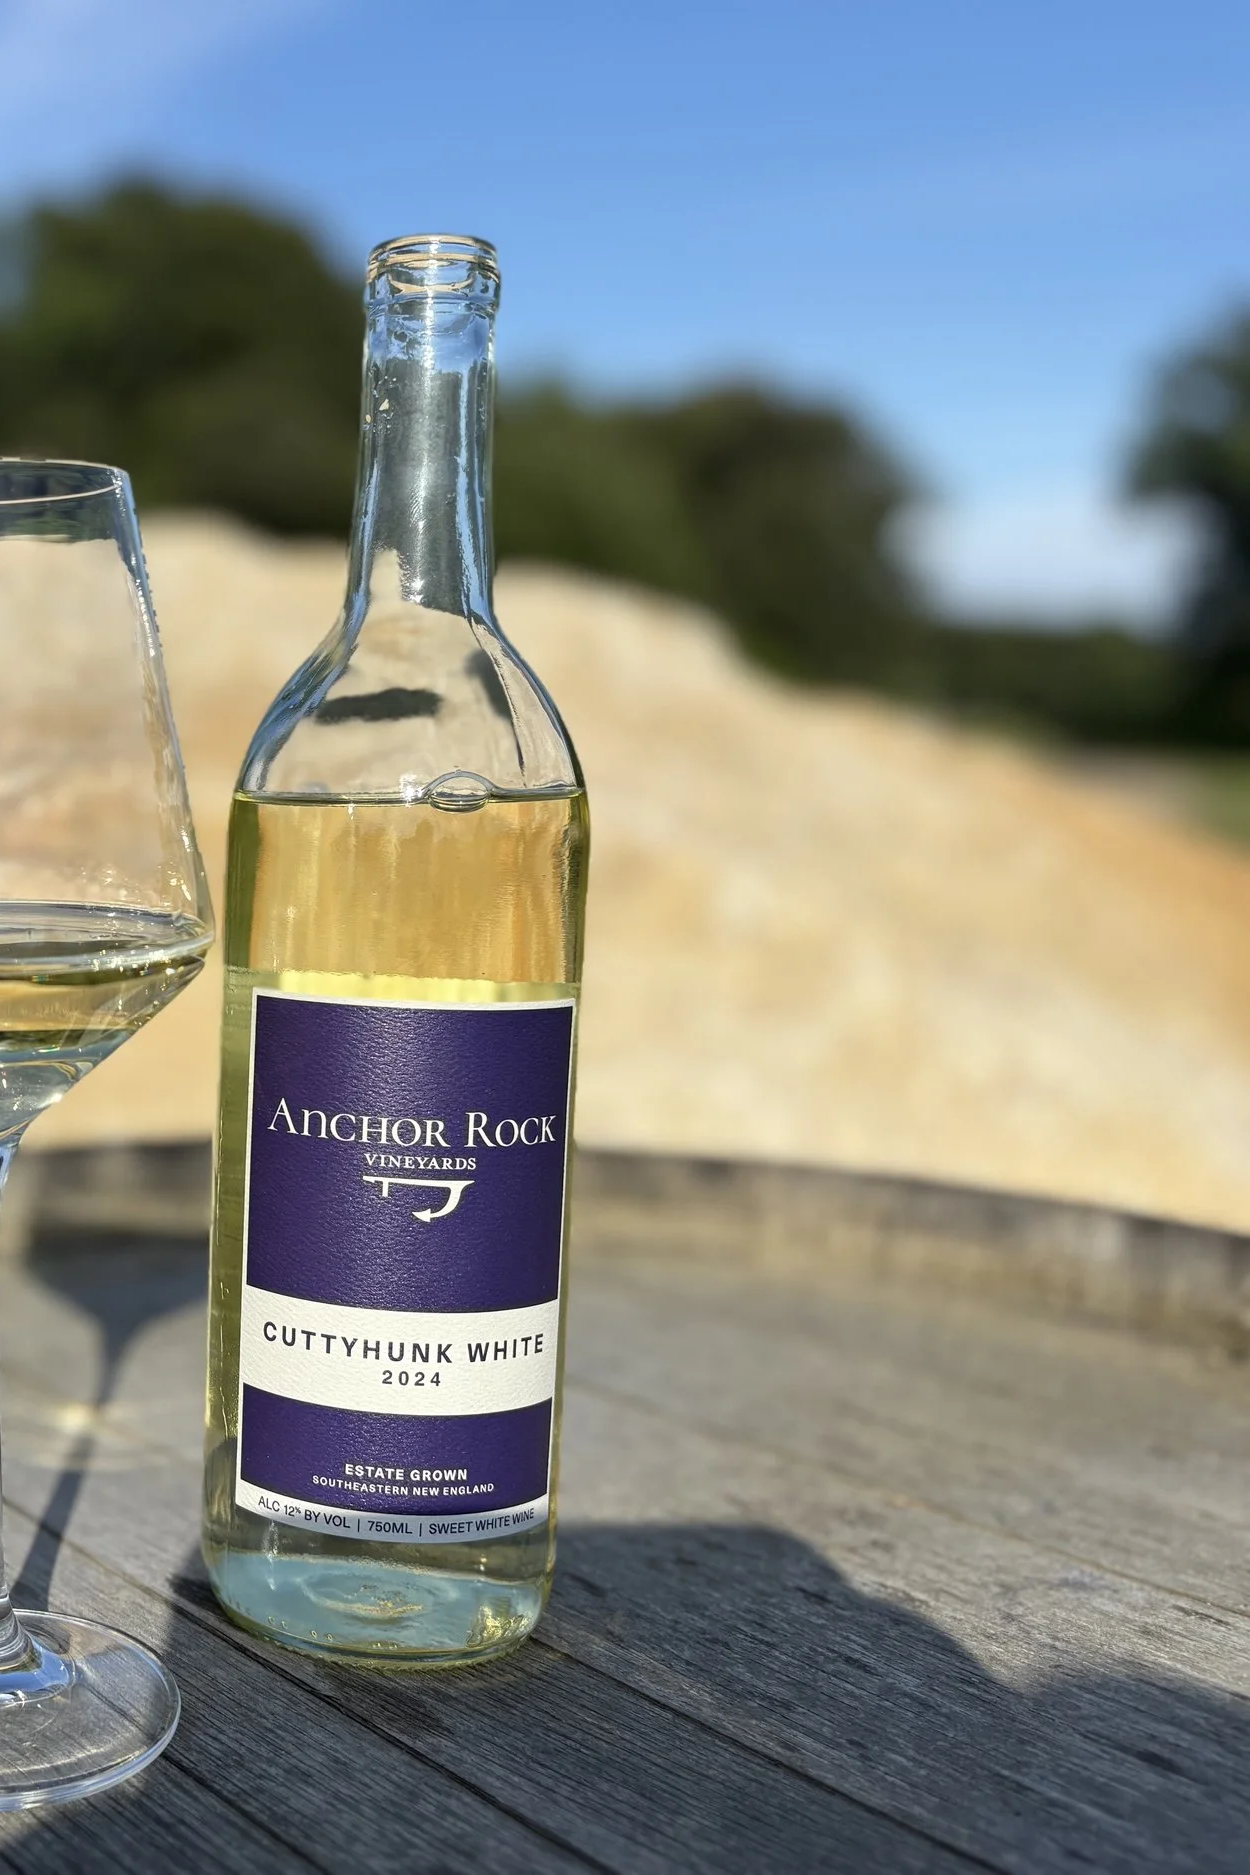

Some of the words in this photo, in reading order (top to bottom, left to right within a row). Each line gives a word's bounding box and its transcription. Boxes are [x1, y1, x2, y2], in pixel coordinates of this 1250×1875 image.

[364, 1153, 477, 1171] VINEYARDS
[263, 1321, 453, 1364] CUTTYHUNK
[467, 1333, 545, 1363] WHITE
[381, 1369, 442, 1387] 2024
[345, 1463, 405, 1481] ESTATE
[410, 1468, 468, 1482] GROWN
[312, 1475, 409, 1496] SOUTHEASTERN
[412, 1485, 440, 1497] NEW
[442, 1482, 495, 1497] ENGLAND
[258, 1496, 280, 1513] ALC
[304, 1508, 322, 1524] BY
[324, 1513, 351, 1529] VOL
[367, 1520, 413, 1534] 750ML
[428, 1521, 473, 1535] SWEET
[474, 1514, 511, 1532] WHITE
[512, 1507, 535, 1525] WINE
